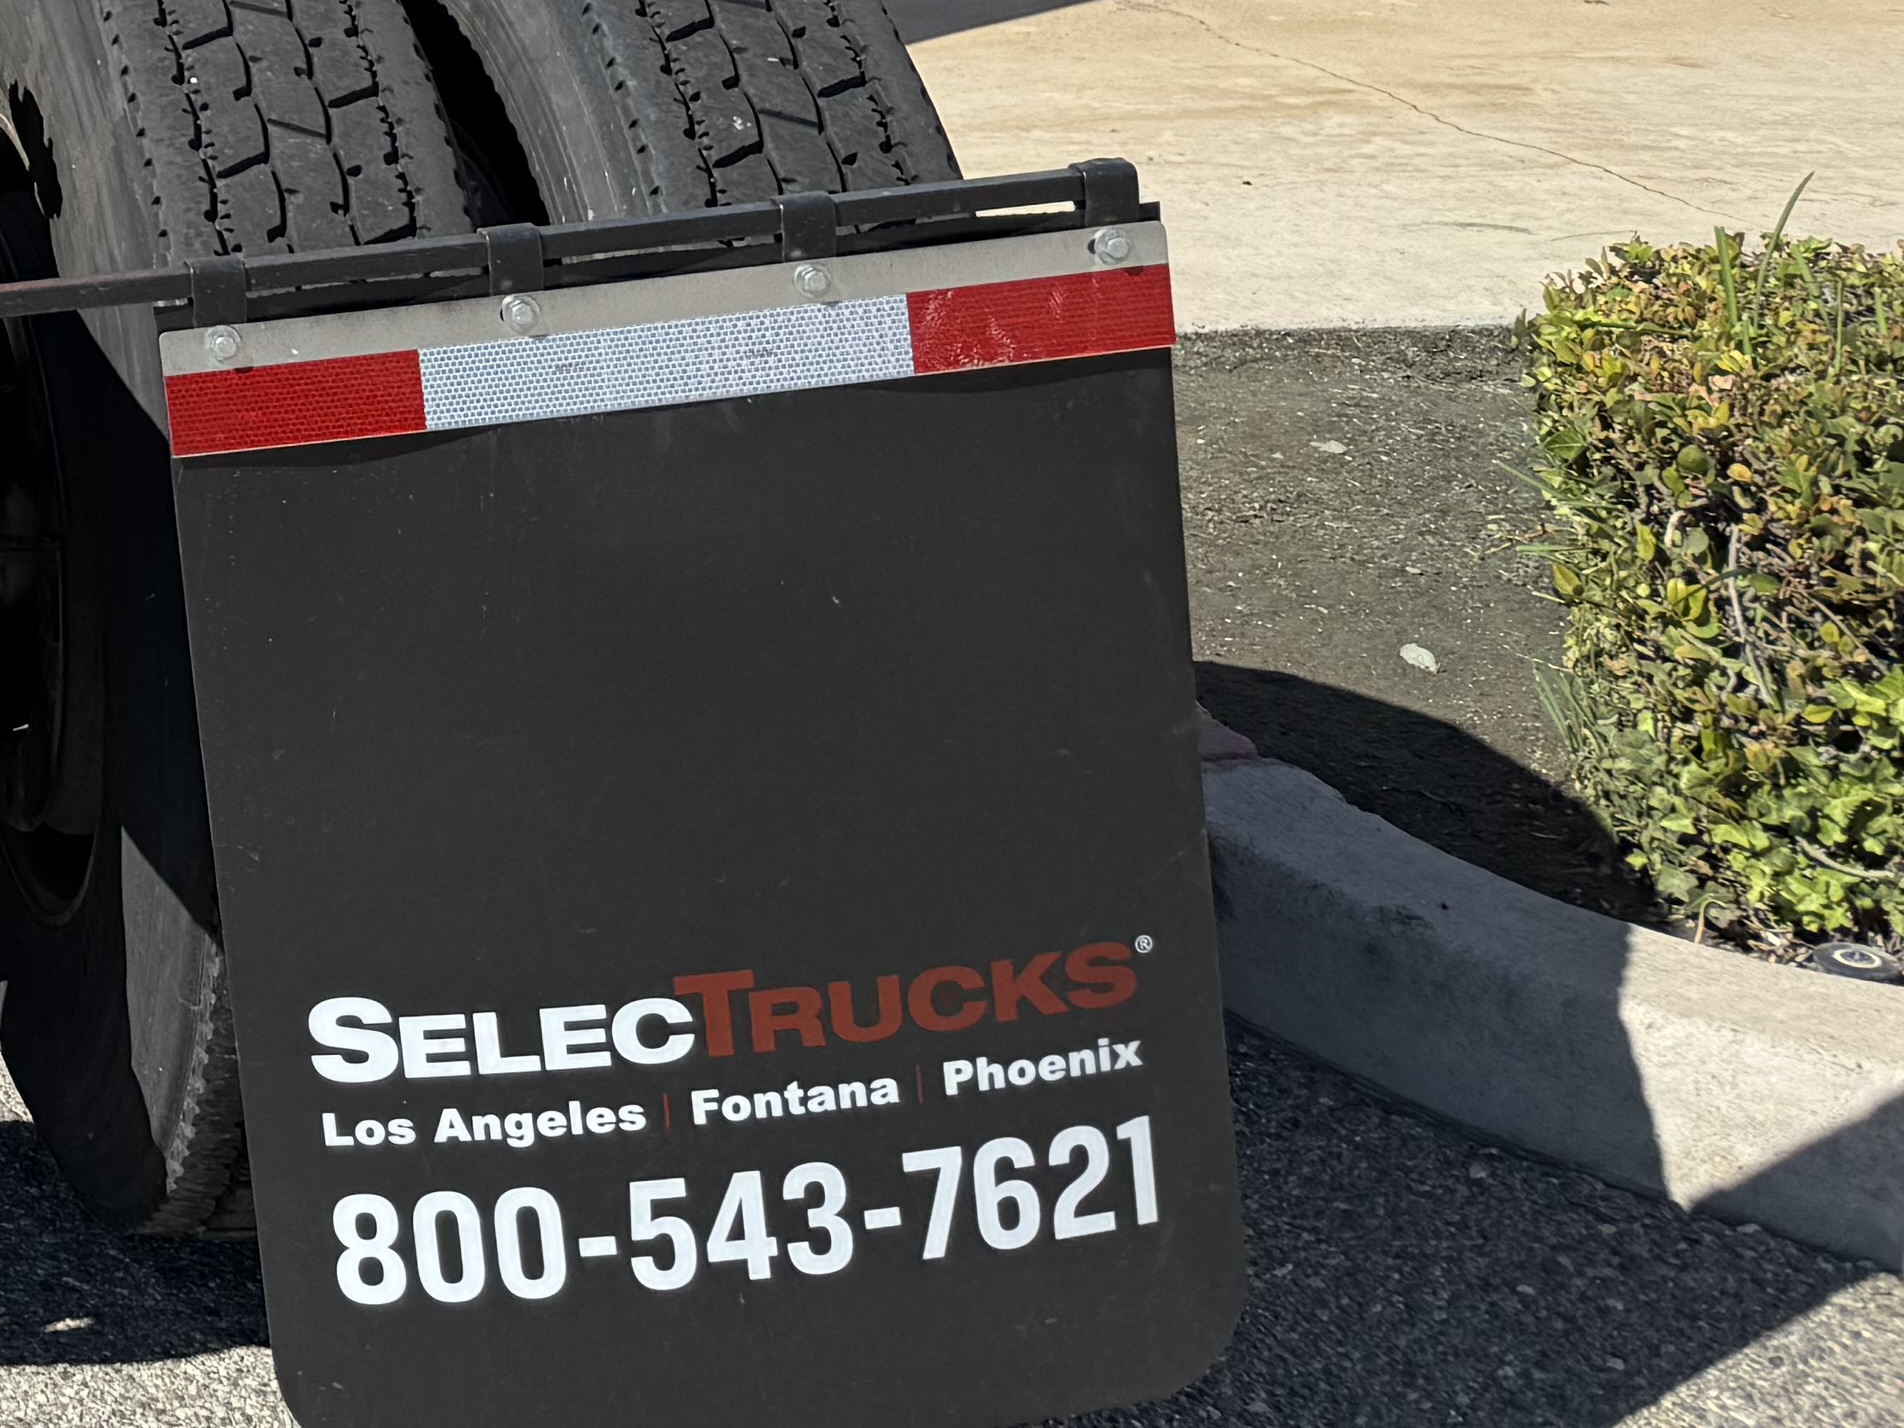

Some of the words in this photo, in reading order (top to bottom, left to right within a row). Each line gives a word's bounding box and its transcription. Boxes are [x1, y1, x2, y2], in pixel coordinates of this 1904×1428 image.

[322, 1112, 416, 1147] Los
[434, 1100, 647, 1149] Angeles
[691, 1077, 900, 1126] Fontana
[943, 1037, 1143, 1097] Phoenix
[332, 1114, 1159, 1306] 800-543-7621
